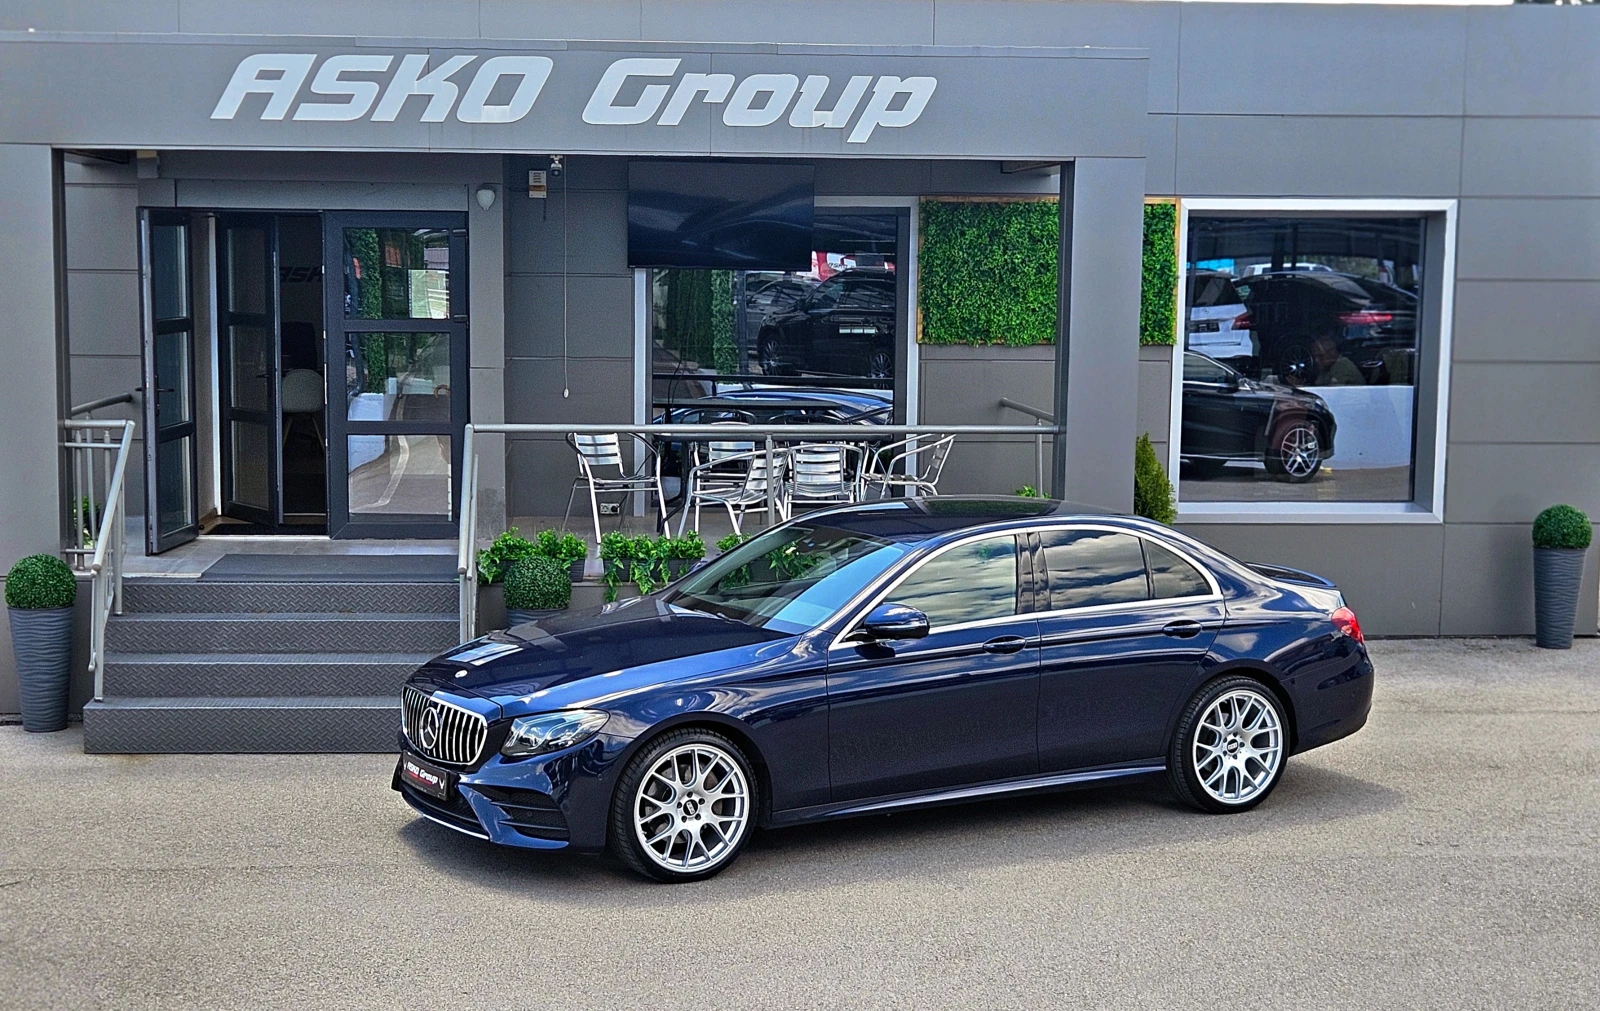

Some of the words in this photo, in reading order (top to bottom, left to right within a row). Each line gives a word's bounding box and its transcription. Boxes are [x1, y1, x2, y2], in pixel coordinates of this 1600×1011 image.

[210, 53, 554, 124] ASKO
[581, 58, 938, 143] Group
[280, 266, 322, 282] ASK
